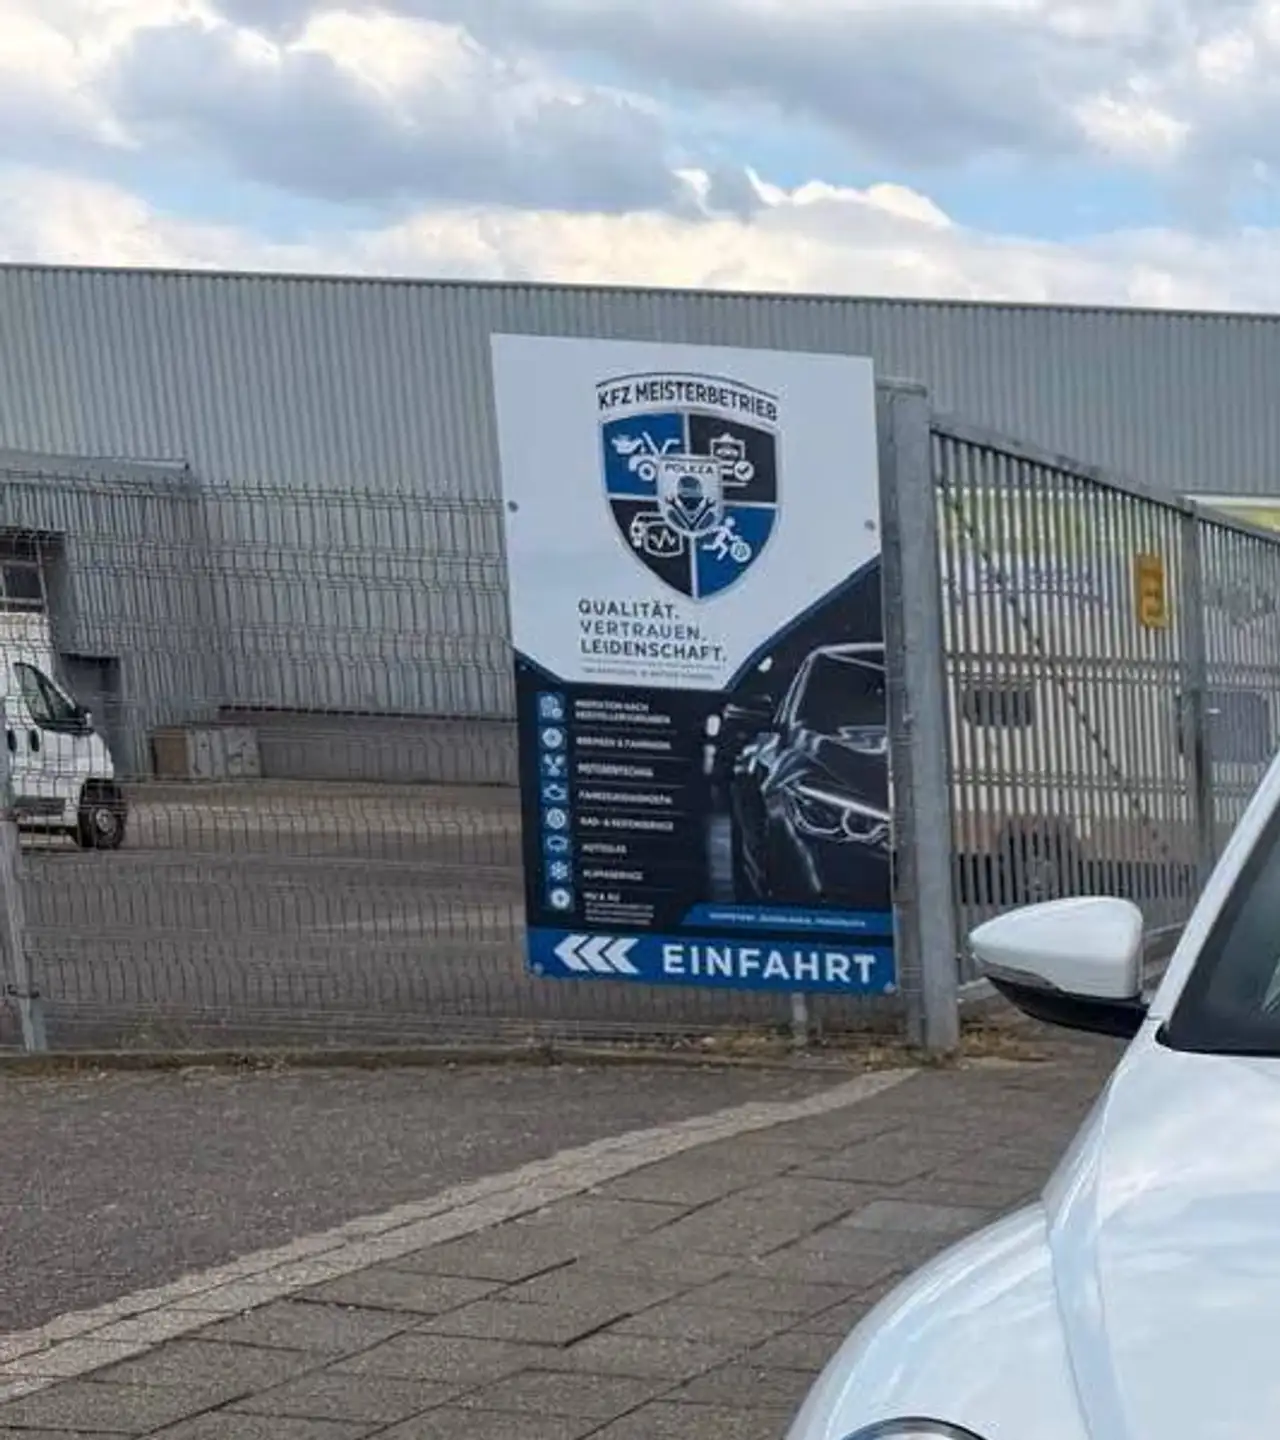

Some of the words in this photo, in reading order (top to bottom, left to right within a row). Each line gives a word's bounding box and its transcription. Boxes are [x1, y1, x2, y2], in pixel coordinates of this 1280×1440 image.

[598, 386, 632, 411] KFZ
[635, 380, 778, 422] MEISTERBETRIEB
[578, 599, 680, 620] QUALITÄT.
[580, 620, 707, 642] VERTRAUEN.
[581, 639, 728, 663] LEIDENSCHAFT.
[662, 943, 876, 984] EINFAHRT
